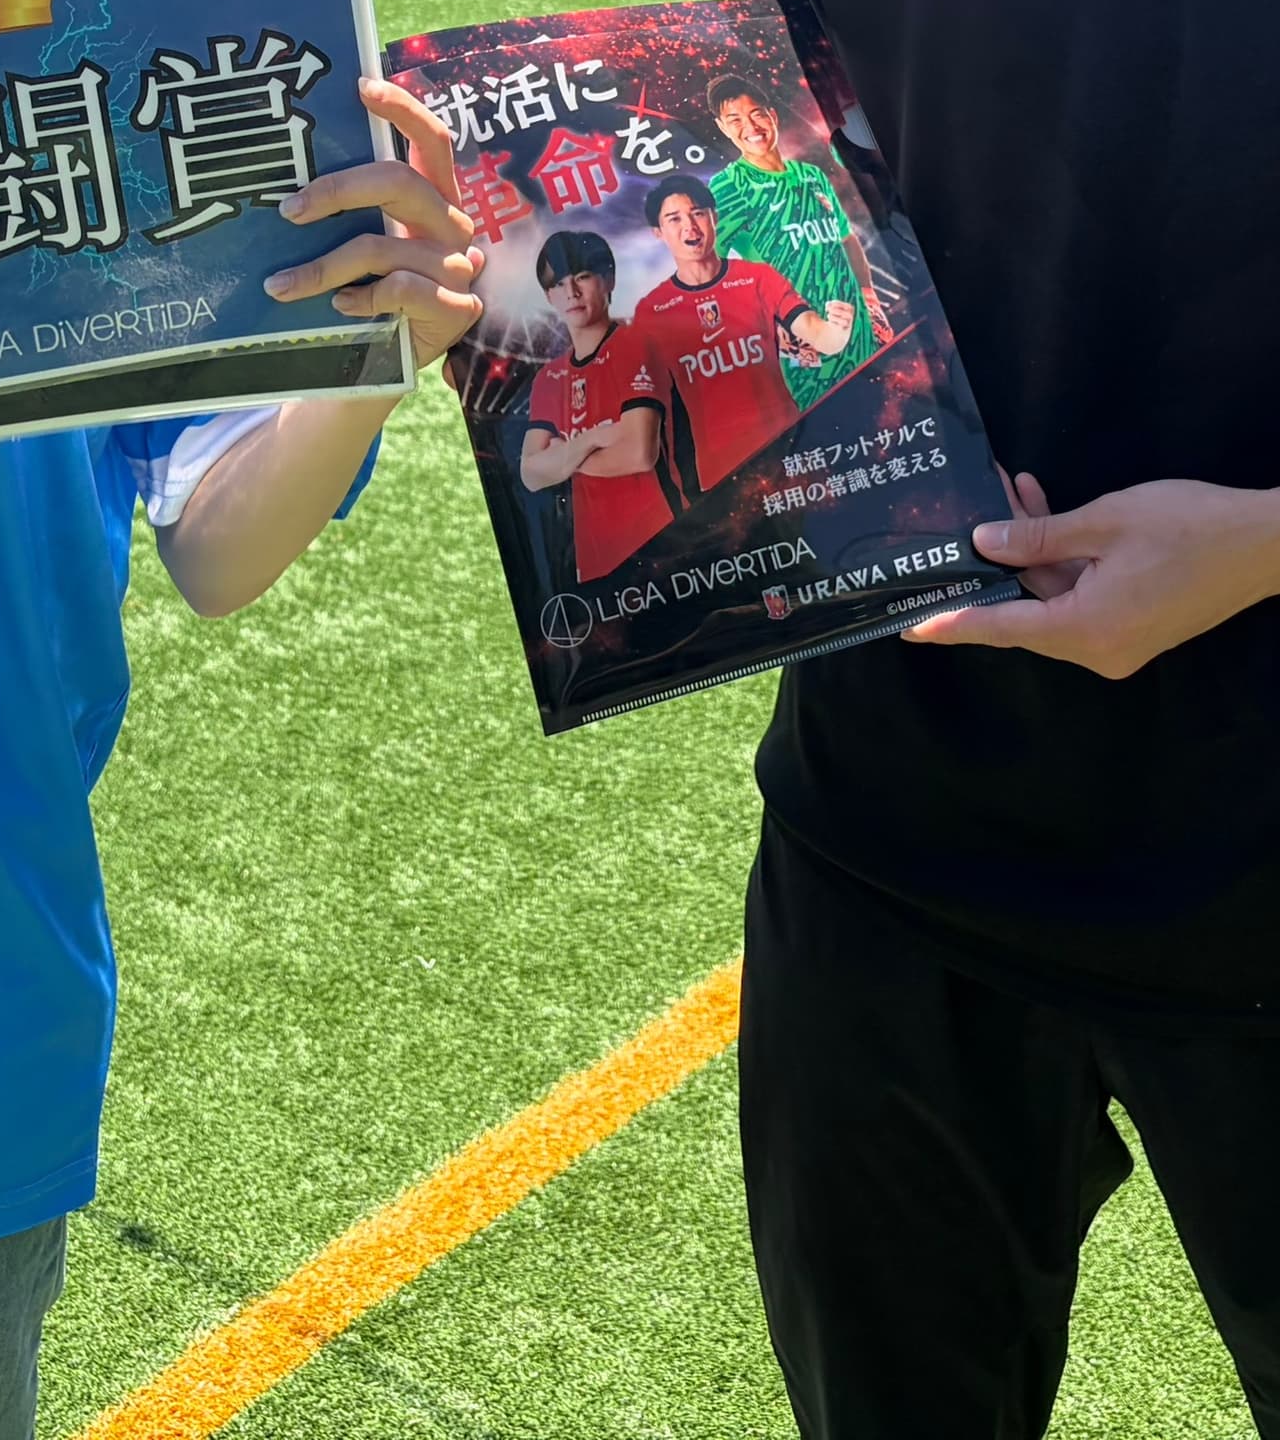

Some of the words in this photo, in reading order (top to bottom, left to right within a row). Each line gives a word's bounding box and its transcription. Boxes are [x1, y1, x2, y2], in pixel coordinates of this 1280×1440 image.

[679, 335, 764, 383] POLUS
[782, 417, 935, 478] 就活フットサルで
[763, 448, 947, 517] 採用の常識を変える
[797, 564, 888, 605] URAWA
[893, 542, 960, 577] REDS
[947, 578, 982, 599] REDS
